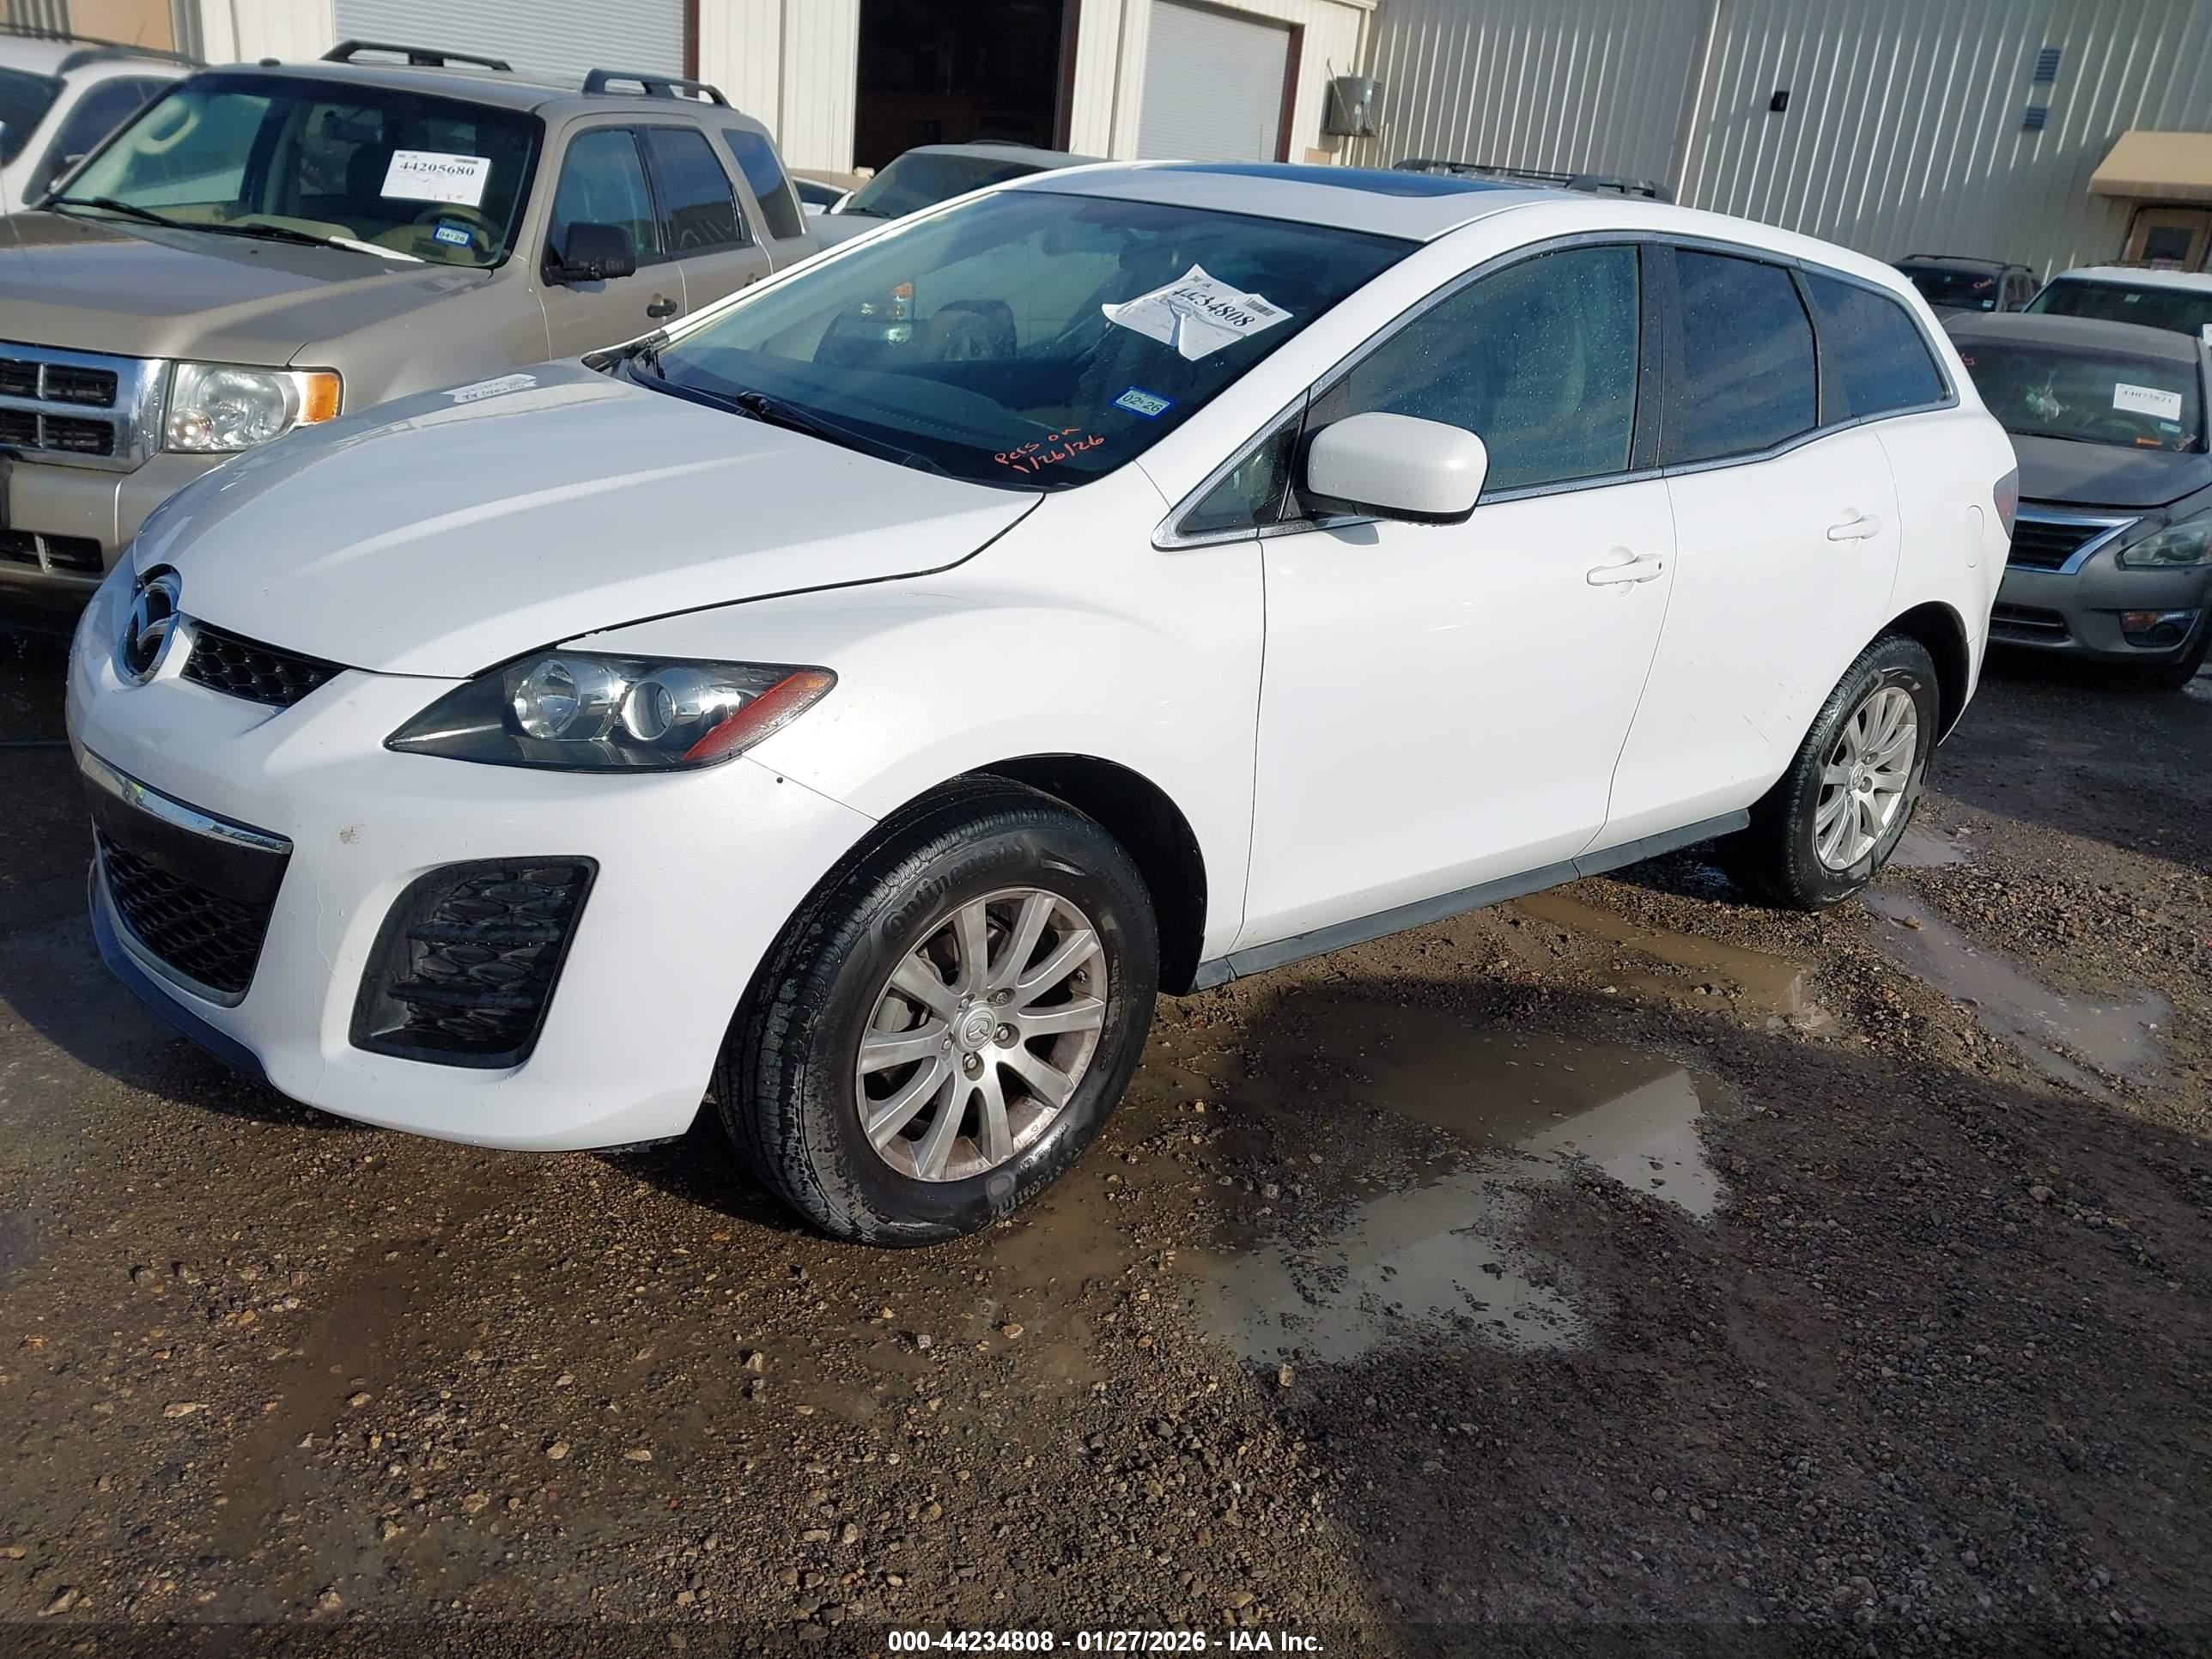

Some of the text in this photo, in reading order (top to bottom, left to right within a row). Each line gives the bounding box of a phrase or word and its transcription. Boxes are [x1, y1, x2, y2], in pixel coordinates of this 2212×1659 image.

[399, 161, 475, 177] 44205680
[1122, 394, 1163, 412] 02 26
